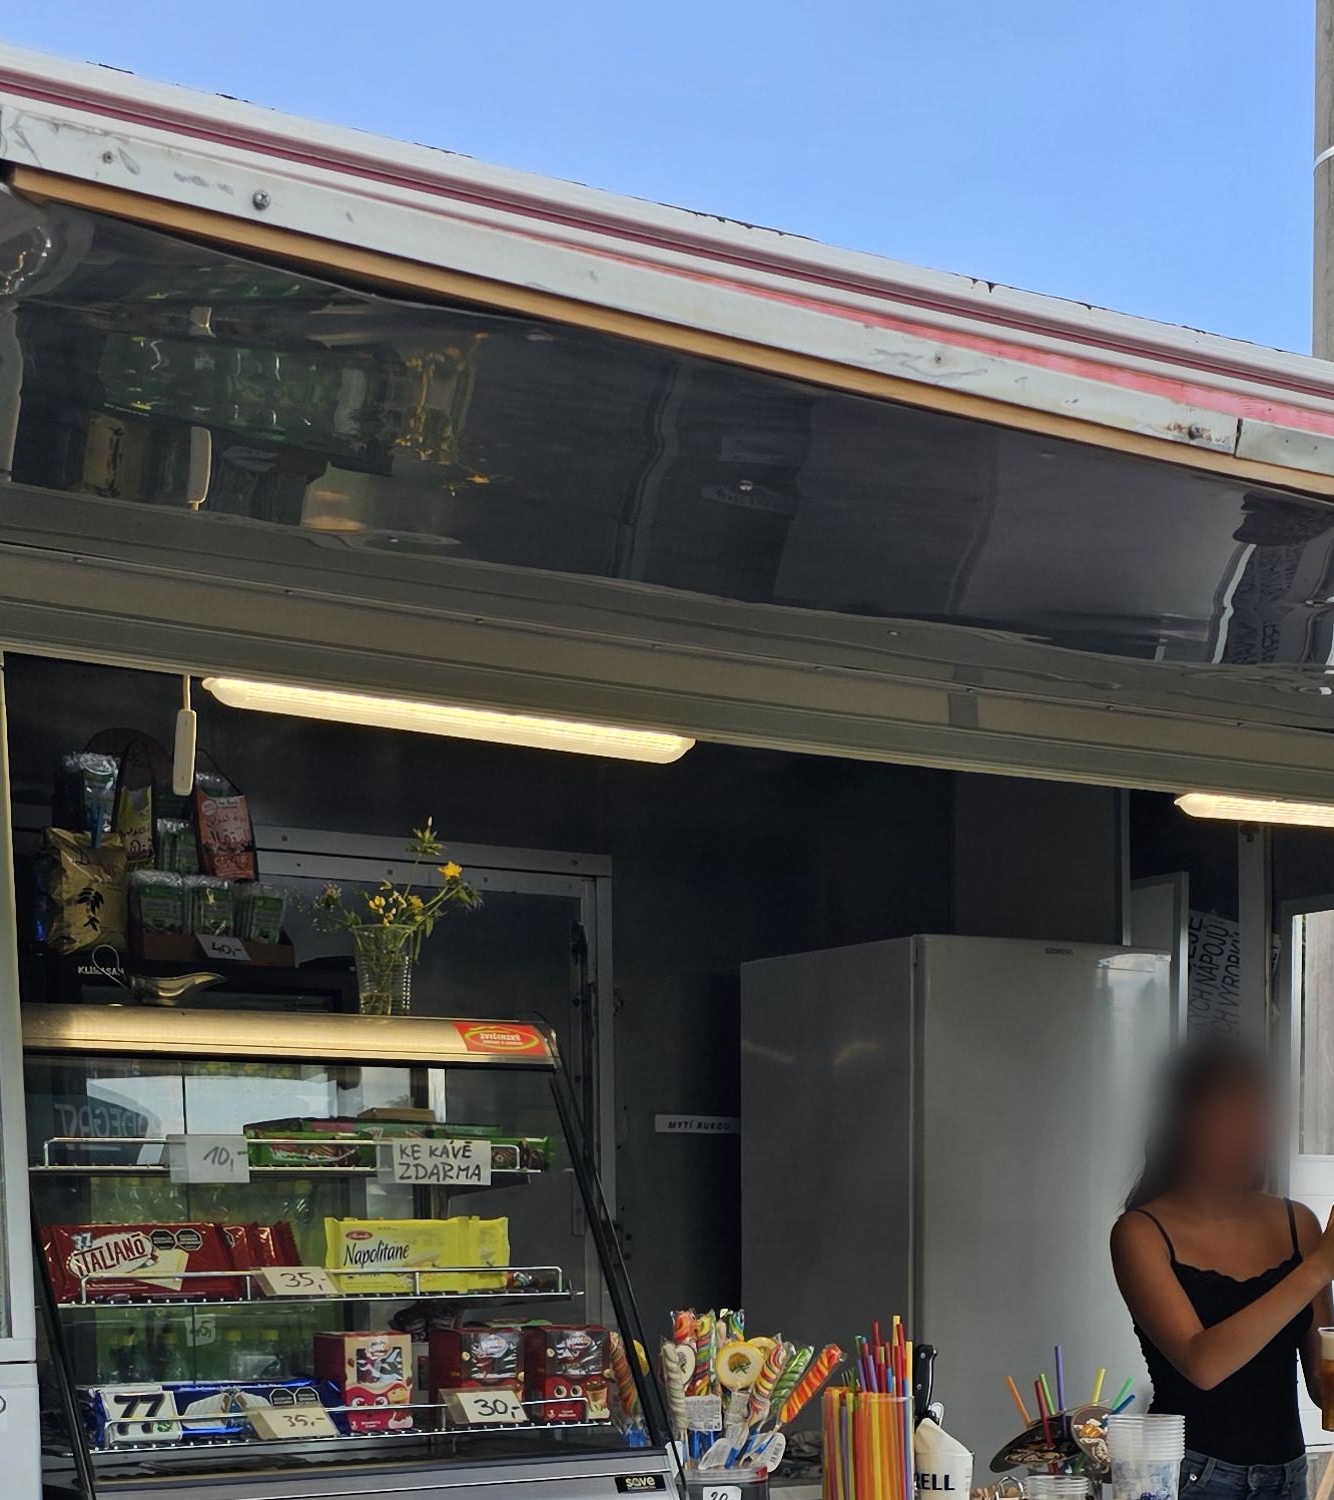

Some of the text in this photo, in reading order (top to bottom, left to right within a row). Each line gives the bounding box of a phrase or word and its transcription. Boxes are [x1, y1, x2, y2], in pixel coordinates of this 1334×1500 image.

[399, 1143, 422, 1161] KE
[398, 1162, 482, 1183] ZDARMA
[343, 1240, 411, 1270] Napolitane
[113, 1393, 165, 1435] 77
[473, 1398, 522, 1420] 30,-
